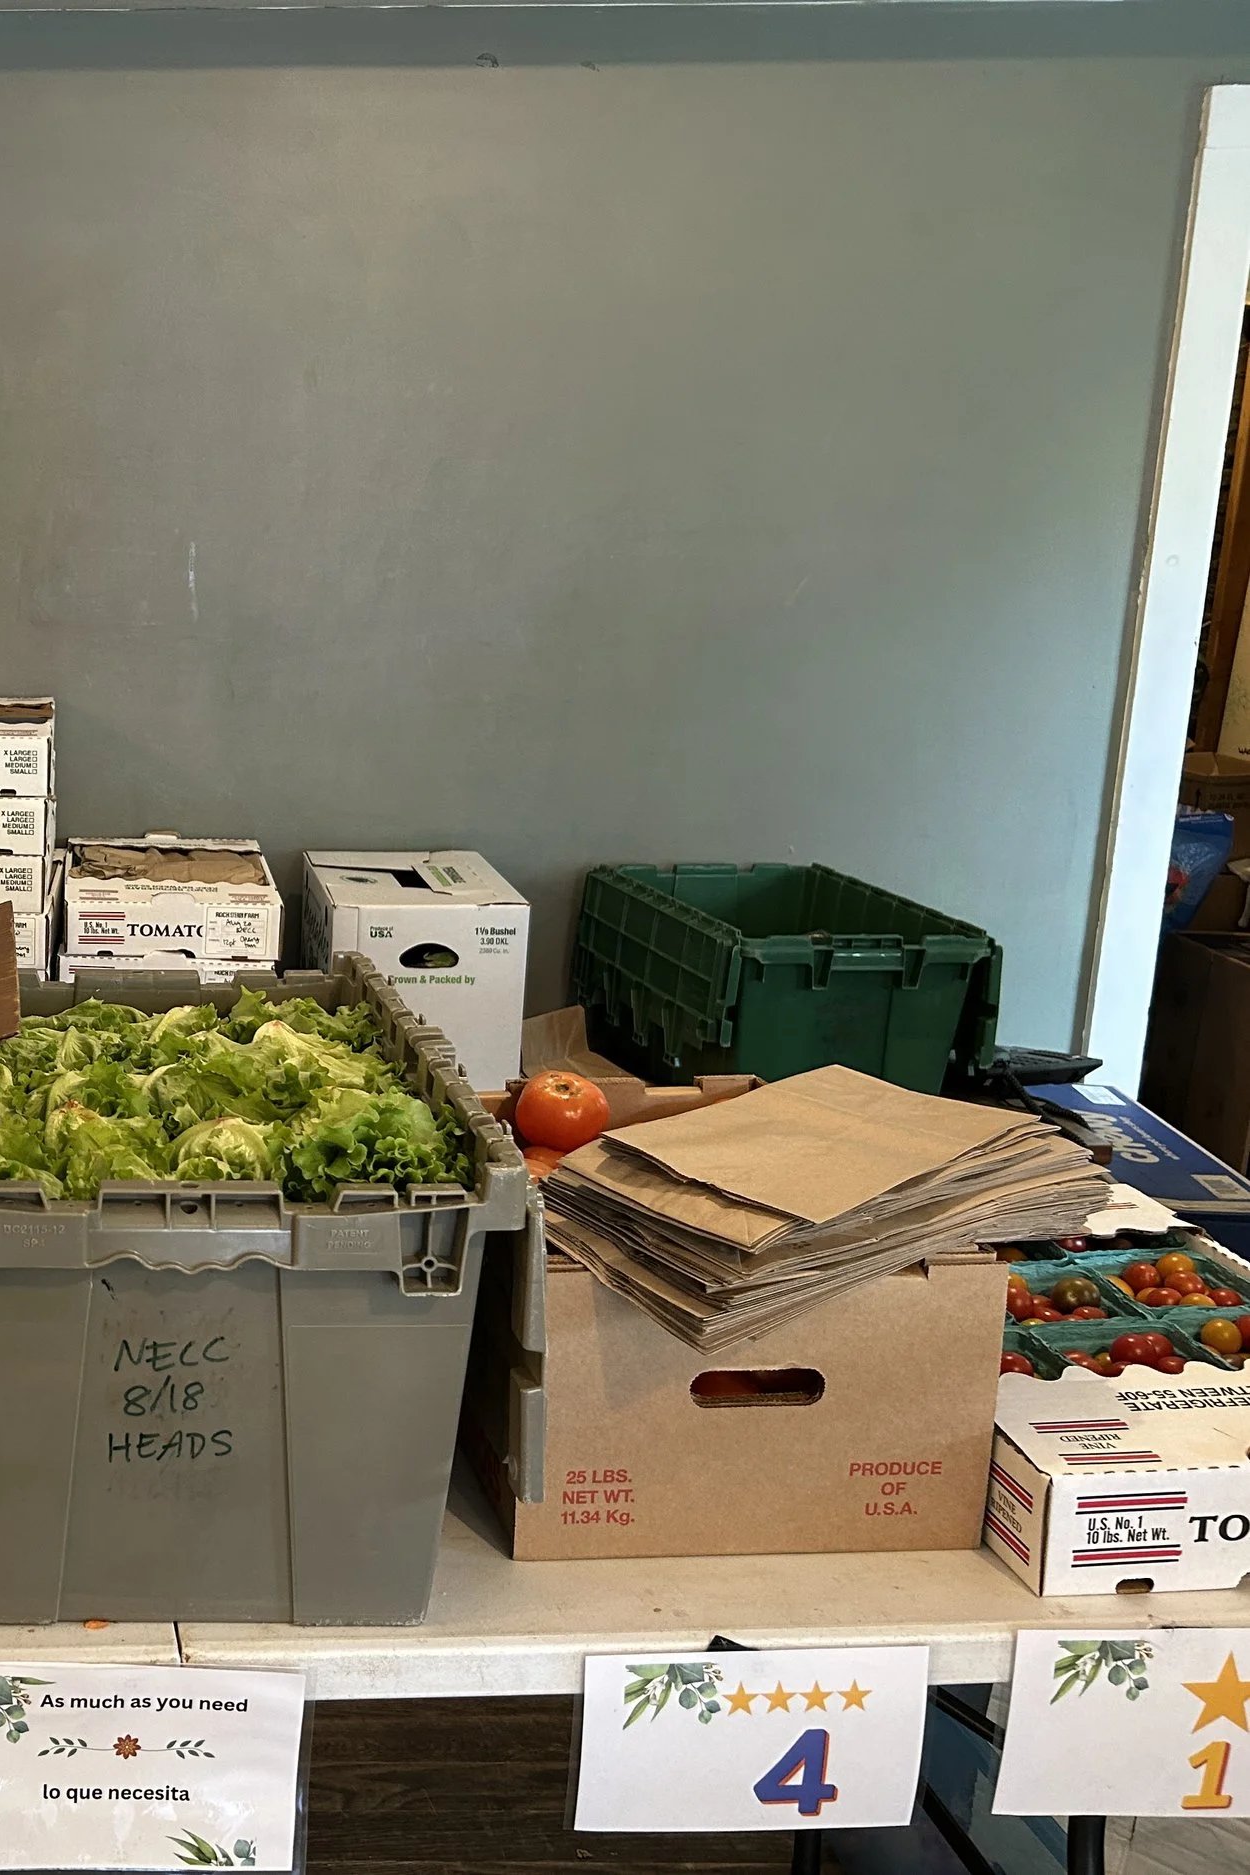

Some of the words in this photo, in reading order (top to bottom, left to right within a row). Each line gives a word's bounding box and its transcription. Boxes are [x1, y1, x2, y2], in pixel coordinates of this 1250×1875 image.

[126, 923, 204, 938] TOMAT
[490, 927, 516, 935] Bushel
[419, 975, 426, 984] &
[429, 975, 462, 984] Packed
[464, 975, 476, 985] by
[330, 1229, 370, 1238] PATENT
[327, 1240, 371, 1250] PENDING
[113, 1335, 232, 1373] NECC
[122, 1374, 205, 1418] 8/18
[1115, 1390, 1177, 1401] 55-60F
[1177, 1386, 1250, 1399] TWEEN
[108, 1429, 234, 1463] HEADS
[1059, 1433, 1122, 1443] RIPENED
[1081, 1442, 1117, 1450] VINE
[566, 1471, 587, 1485] 25
[591, 1469, 632, 1484] LBS.
[849, 1461, 943, 1477] PRODUCE
[880, 1481, 907, 1496] OF
[562, 1490, 599, 1505] NET
[603, 1489, 636, 1504] WT.
[998, 1490, 1017, 1515] VINE
[560, 1510, 601, 1526] 11.34
[606, 1508, 636, 1526] Kg.
[864, 1501, 918, 1517] U.S.A.
[990, 1497, 1023, 1534] RIPENED
[1088, 1517, 1110, 1531] U.S.
[1115, 1517, 1134, 1530] No.
[1137, 1516, 1143, 1529] 1
[1086, 1531, 1100, 1544] 10
[1103, 1530, 1123, 1543] lbs.
[1127, 1529, 1147, 1543] Net
[1151, 1527, 1170, 1541] Wt.
[40, 1694, 65, 1708] As
[70, 1695, 125, 1709] much
[130, 1698, 151, 1708] as
[155, 1698, 193, 1712] you
[199, 1698, 248, 1712] need
[753, 1728, 838, 1817] 4
[1180, 1739, 1232, 1810] 1
[43, 1783, 61, 1800] lo
[66, 1788, 102, 1803] que
[108, 1785, 190, 1801] necesita
